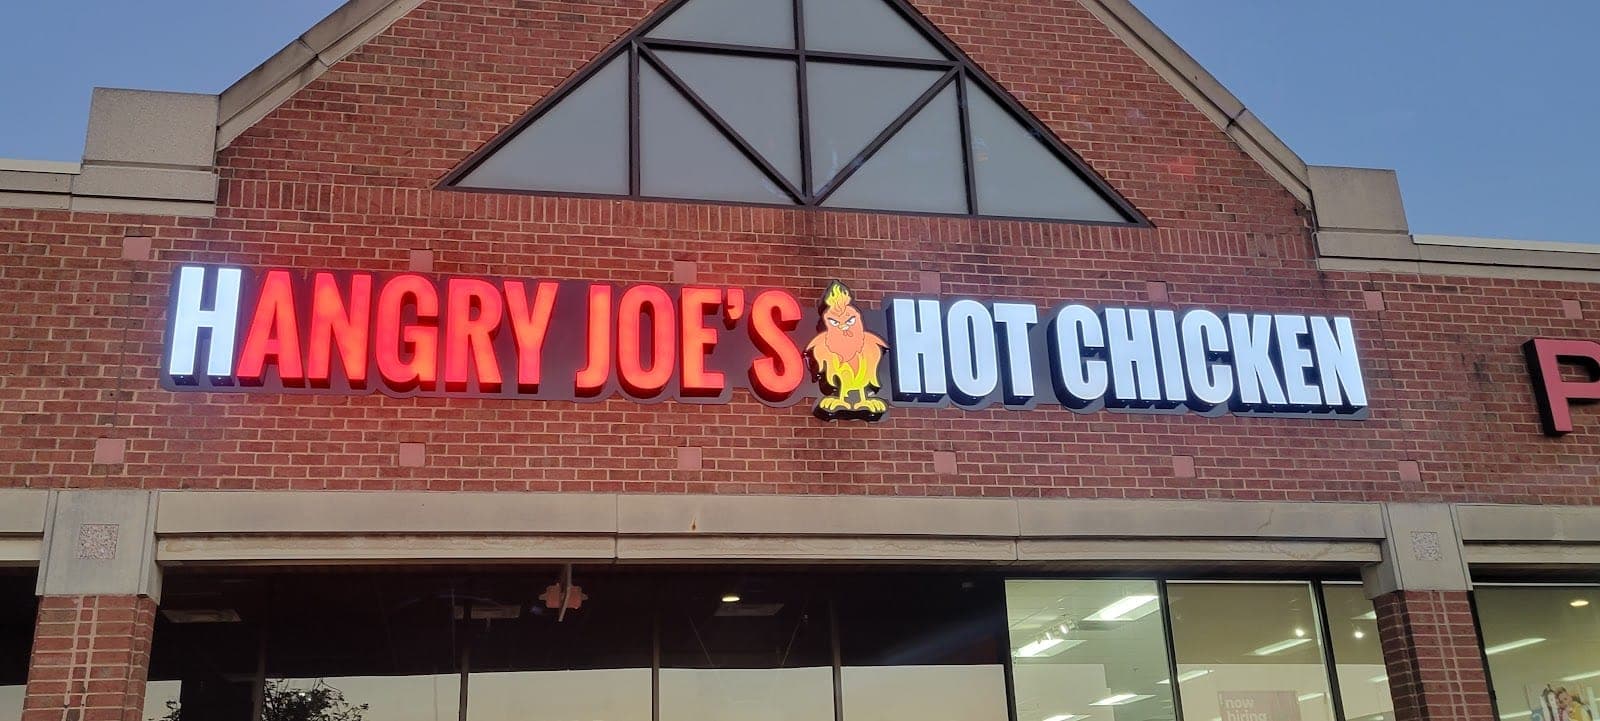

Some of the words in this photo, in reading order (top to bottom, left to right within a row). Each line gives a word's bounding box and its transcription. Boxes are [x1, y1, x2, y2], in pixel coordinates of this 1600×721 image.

[169, 266, 561, 389] HANGRY
[575, 283, 805, 395] JOE'S
[891, 298, 1038, 401] HOT
[1052, 303, 1369, 408] CHICKEN
[1224, 698, 1255, 709] now
